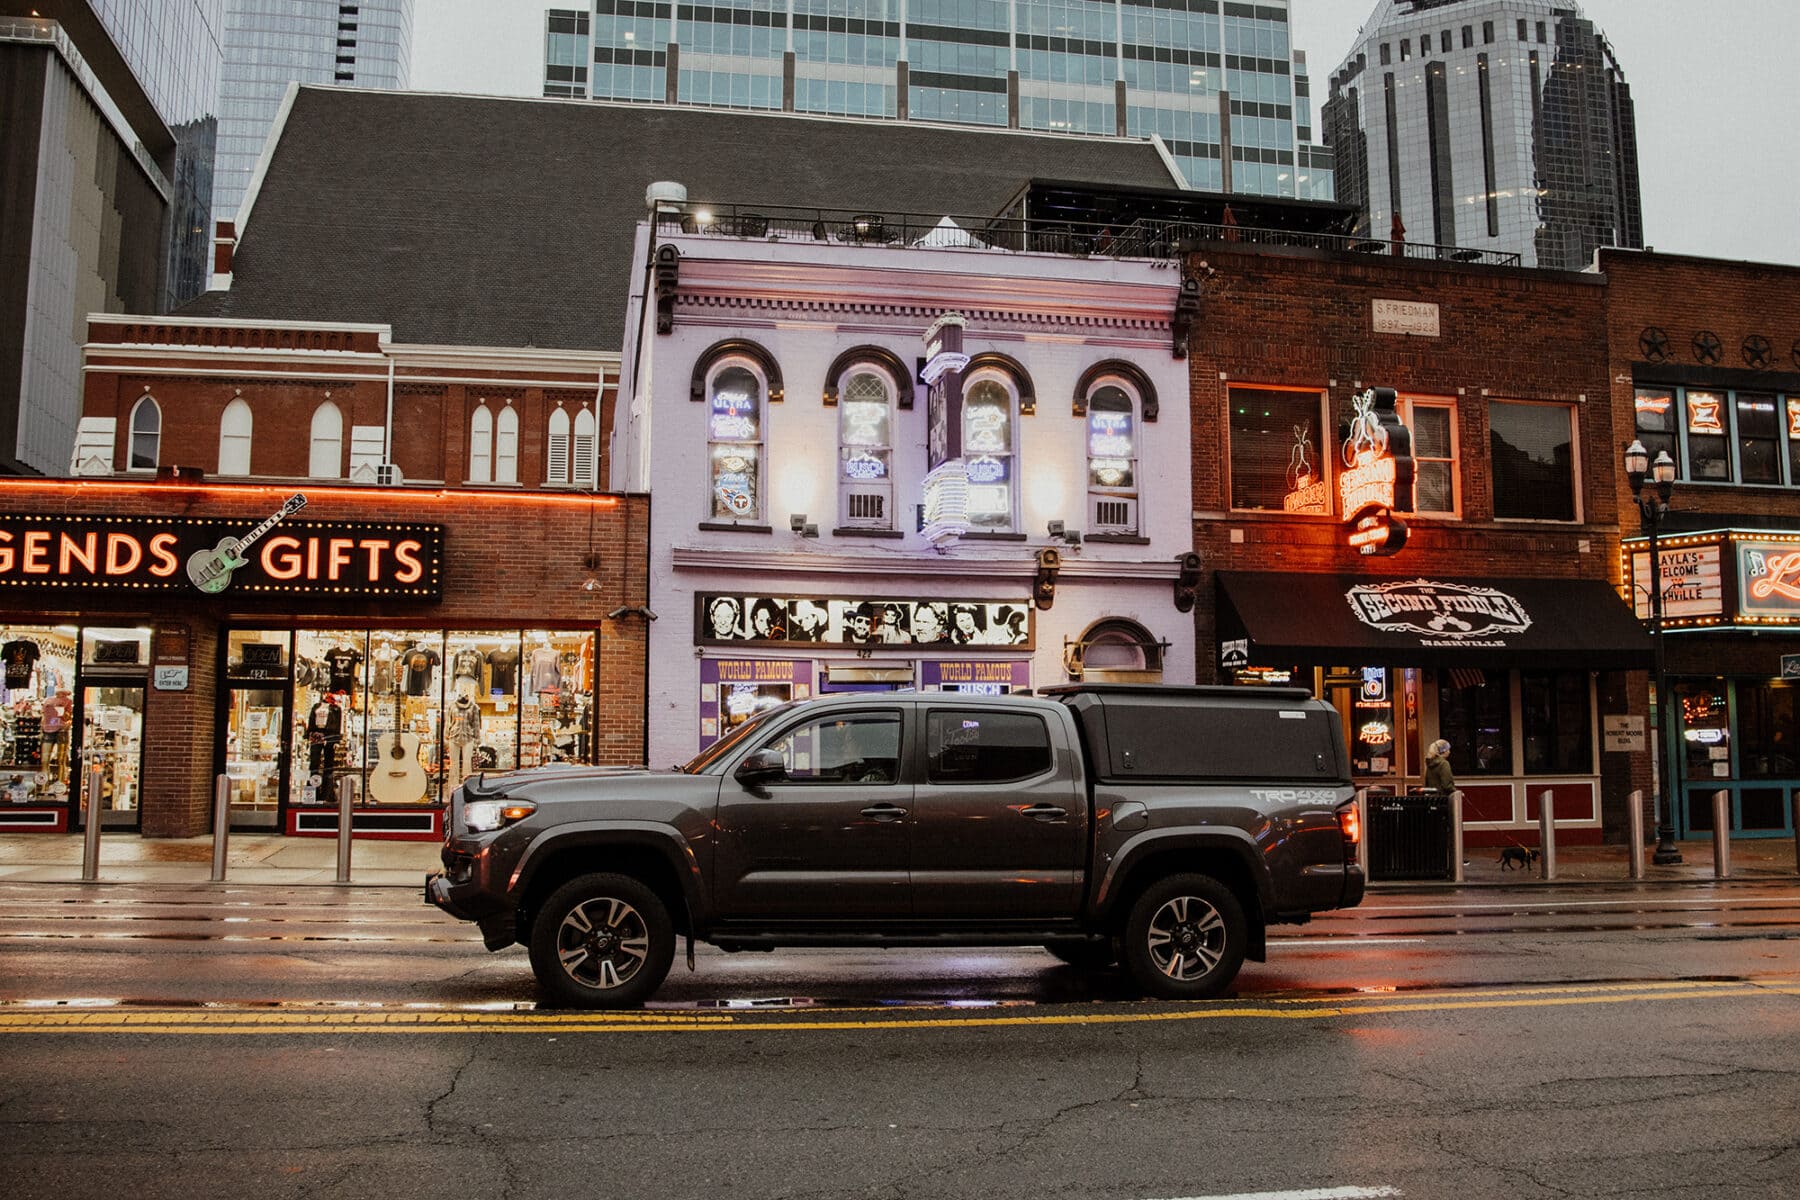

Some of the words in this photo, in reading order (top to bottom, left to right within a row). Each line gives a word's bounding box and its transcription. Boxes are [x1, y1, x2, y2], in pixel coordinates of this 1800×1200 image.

[260, 536, 423, 583] GIFTS
[1660, 552, 1698, 564] AYLA'S
[1359, 594, 1437, 622] SECOND
[1437, 596, 1521, 624] FIDDLE
[1420, 639, 1506, 647] NASHVILLE
[856, 650, 873, 658] 422
[717, 661, 752, 680] WORLD
[755, 661, 794, 680] FAMOUS
[939, 663, 972, 681] WORLD
[975, 663, 1012, 681] FAMOUS
[957, 683, 1001, 696] BUSCH
[1359, 732, 1392, 744] PIZZA
[1249, 790, 1297, 803] TRD
